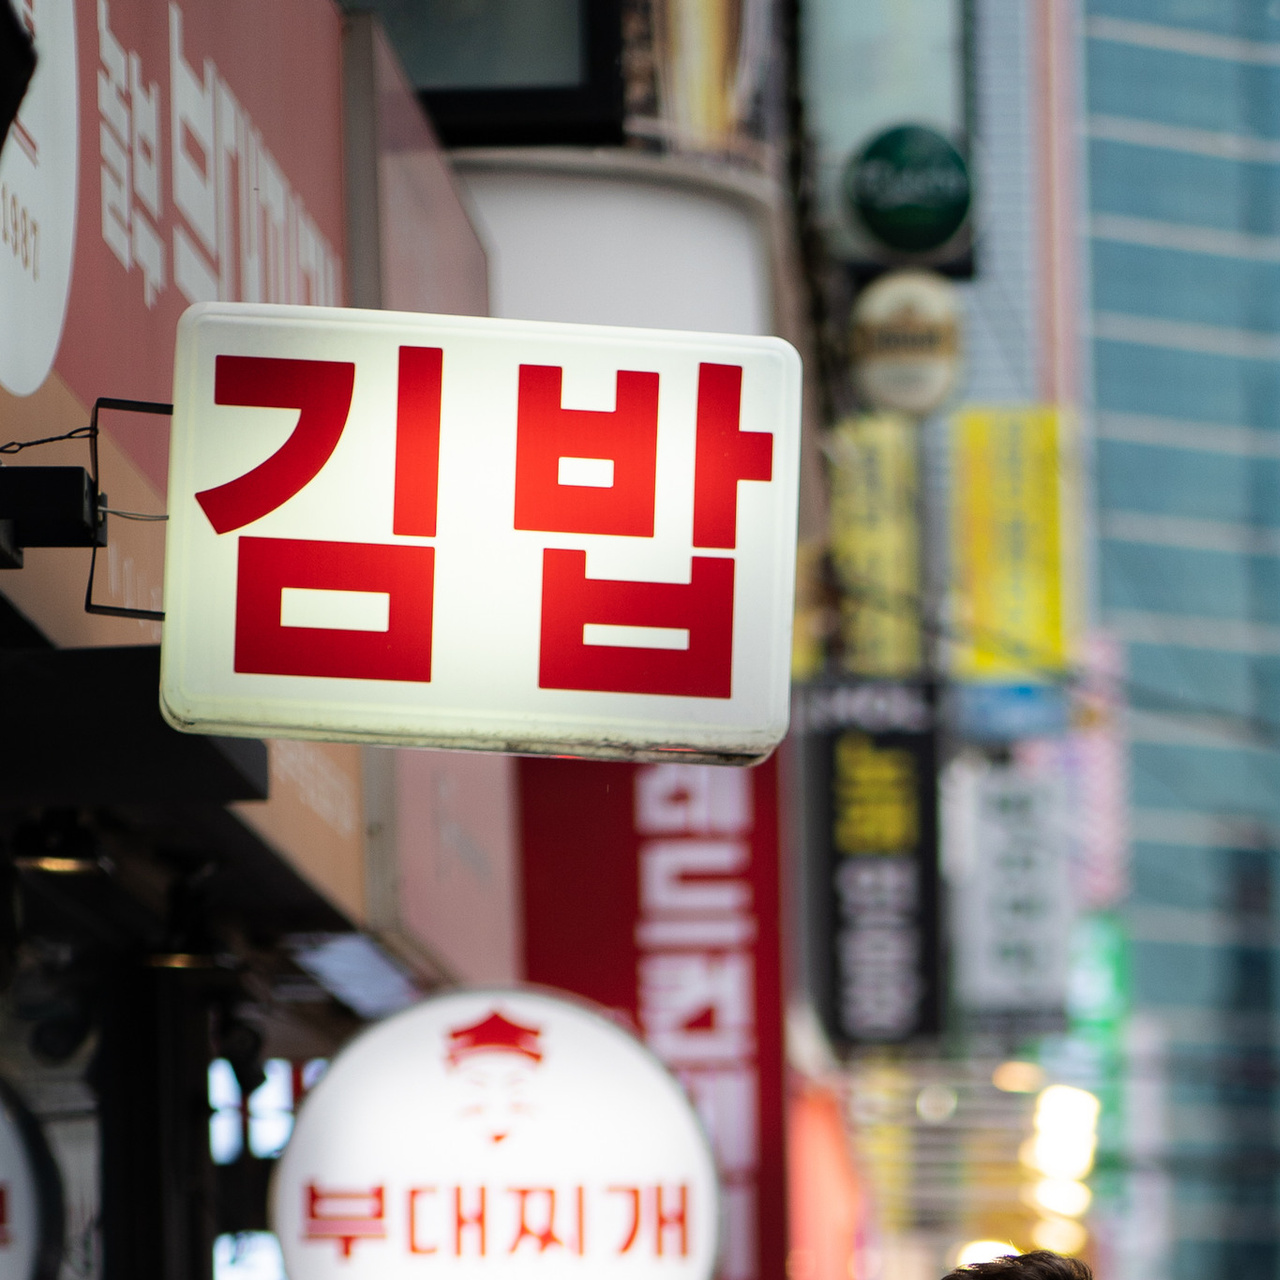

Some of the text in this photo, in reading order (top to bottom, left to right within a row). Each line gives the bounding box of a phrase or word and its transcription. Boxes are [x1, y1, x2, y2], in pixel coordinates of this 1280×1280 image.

[1, 183, 40, 282] 1987
[194, 345, 773, 699] 김밥
[304, 1180, 690, 1259] 부대찌개
